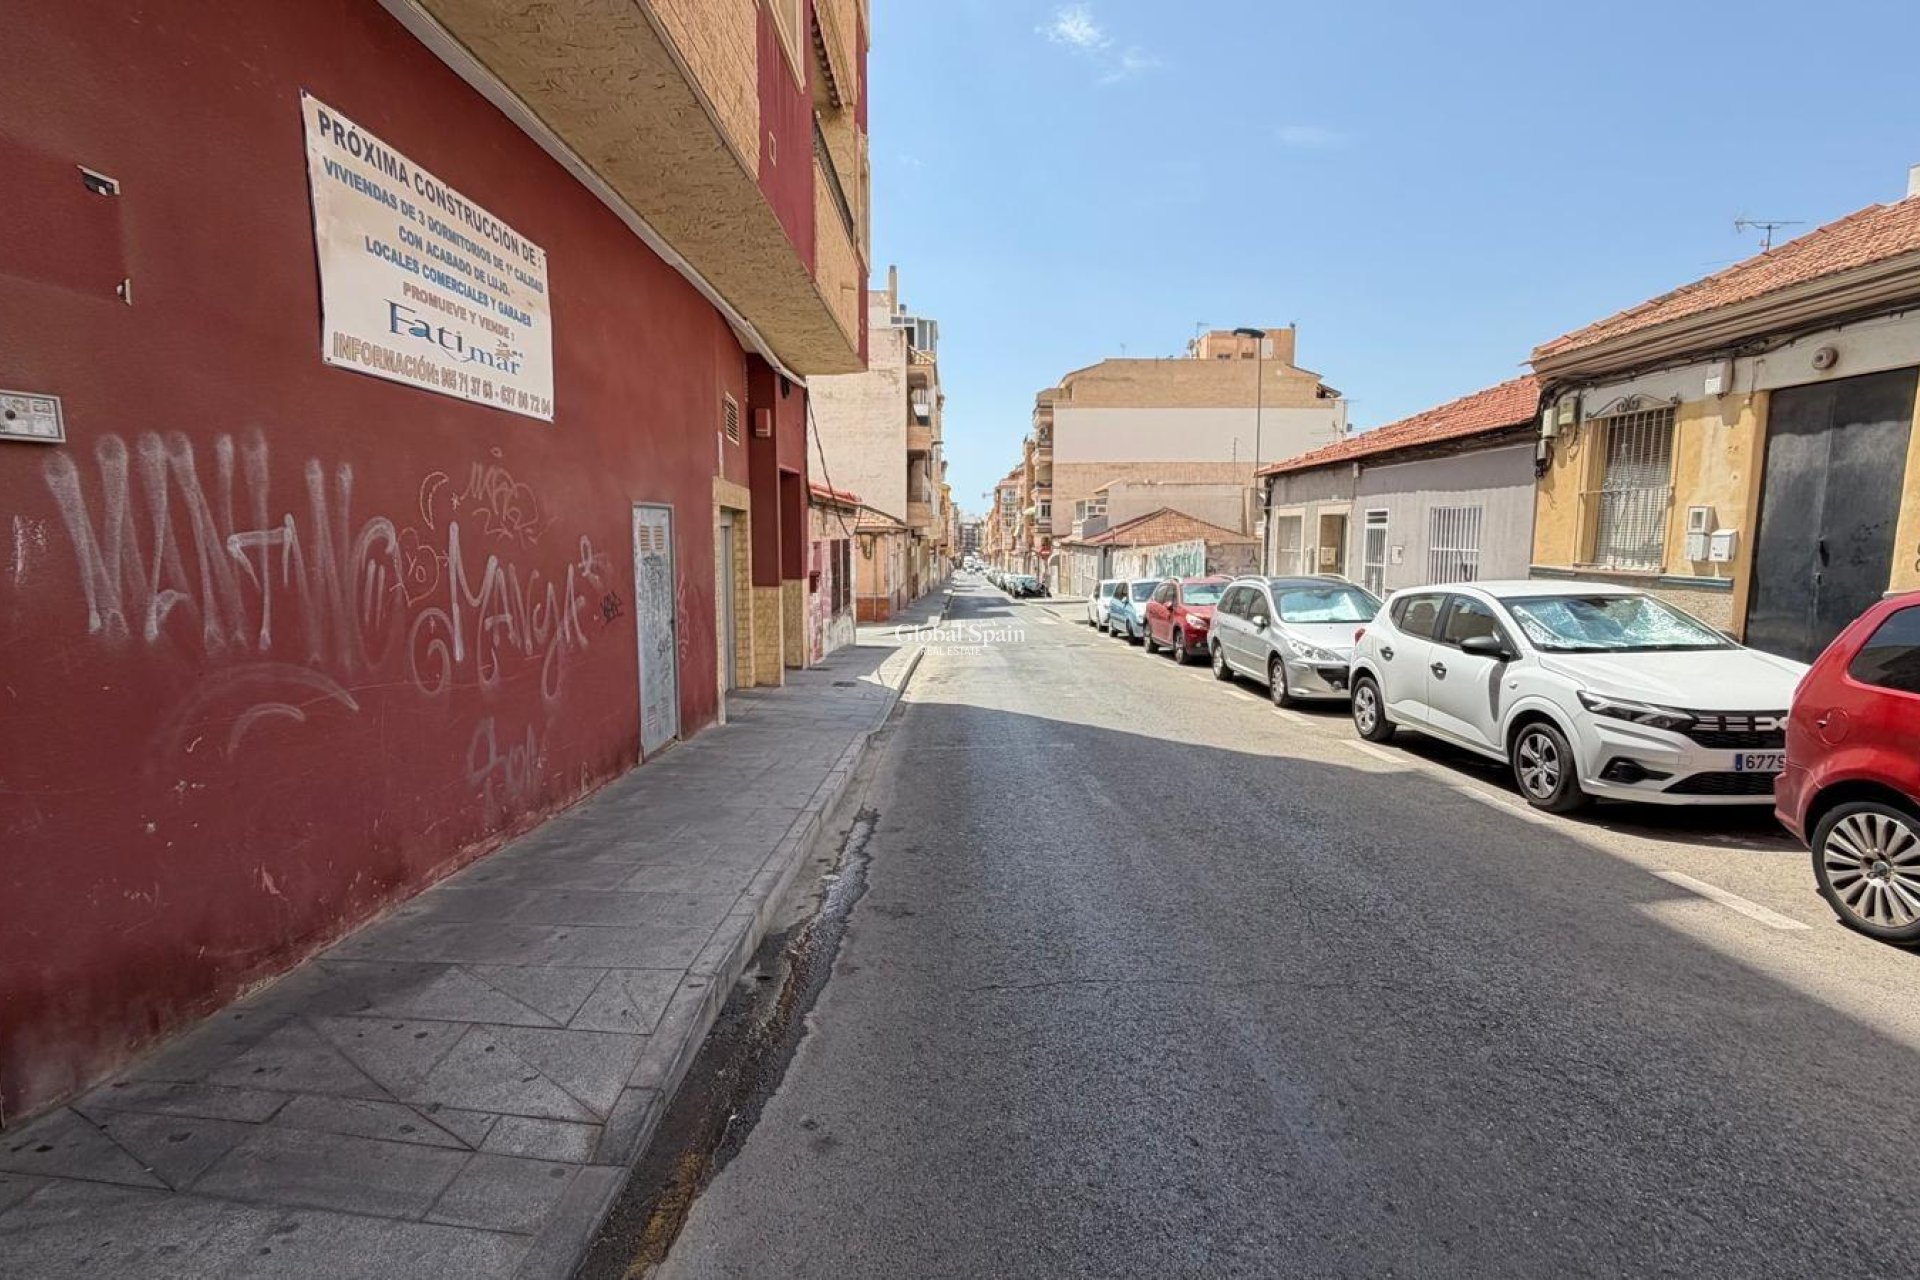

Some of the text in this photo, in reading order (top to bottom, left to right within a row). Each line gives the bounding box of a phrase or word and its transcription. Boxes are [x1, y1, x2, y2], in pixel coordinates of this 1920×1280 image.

[317, 108, 410, 188] PRÓXIMA
[414, 171, 518, 256] CONSTRUCCIÓN
[322, 154, 397, 210] VIVIENDAS
[399, 199, 416, 220] DE
[418, 210, 426, 226] 3
[427, 215, 490, 264] DORMITORIOS
[492, 254, 504, 271] DE
[514, 267, 544, 293] CALIDAD
[364, 235, 531, 327] LOCALES COMERCIALES Y GARAJES
[398, 225, 422, 250] CON
[425, 240, 471, 275] ACABADO
[473, 265, 486, 283] DE
[383, 298, 520, 375] Fatimar
[402, 281, 466, 320] PROMUEVE
[468, 310, 476, 324] Y
